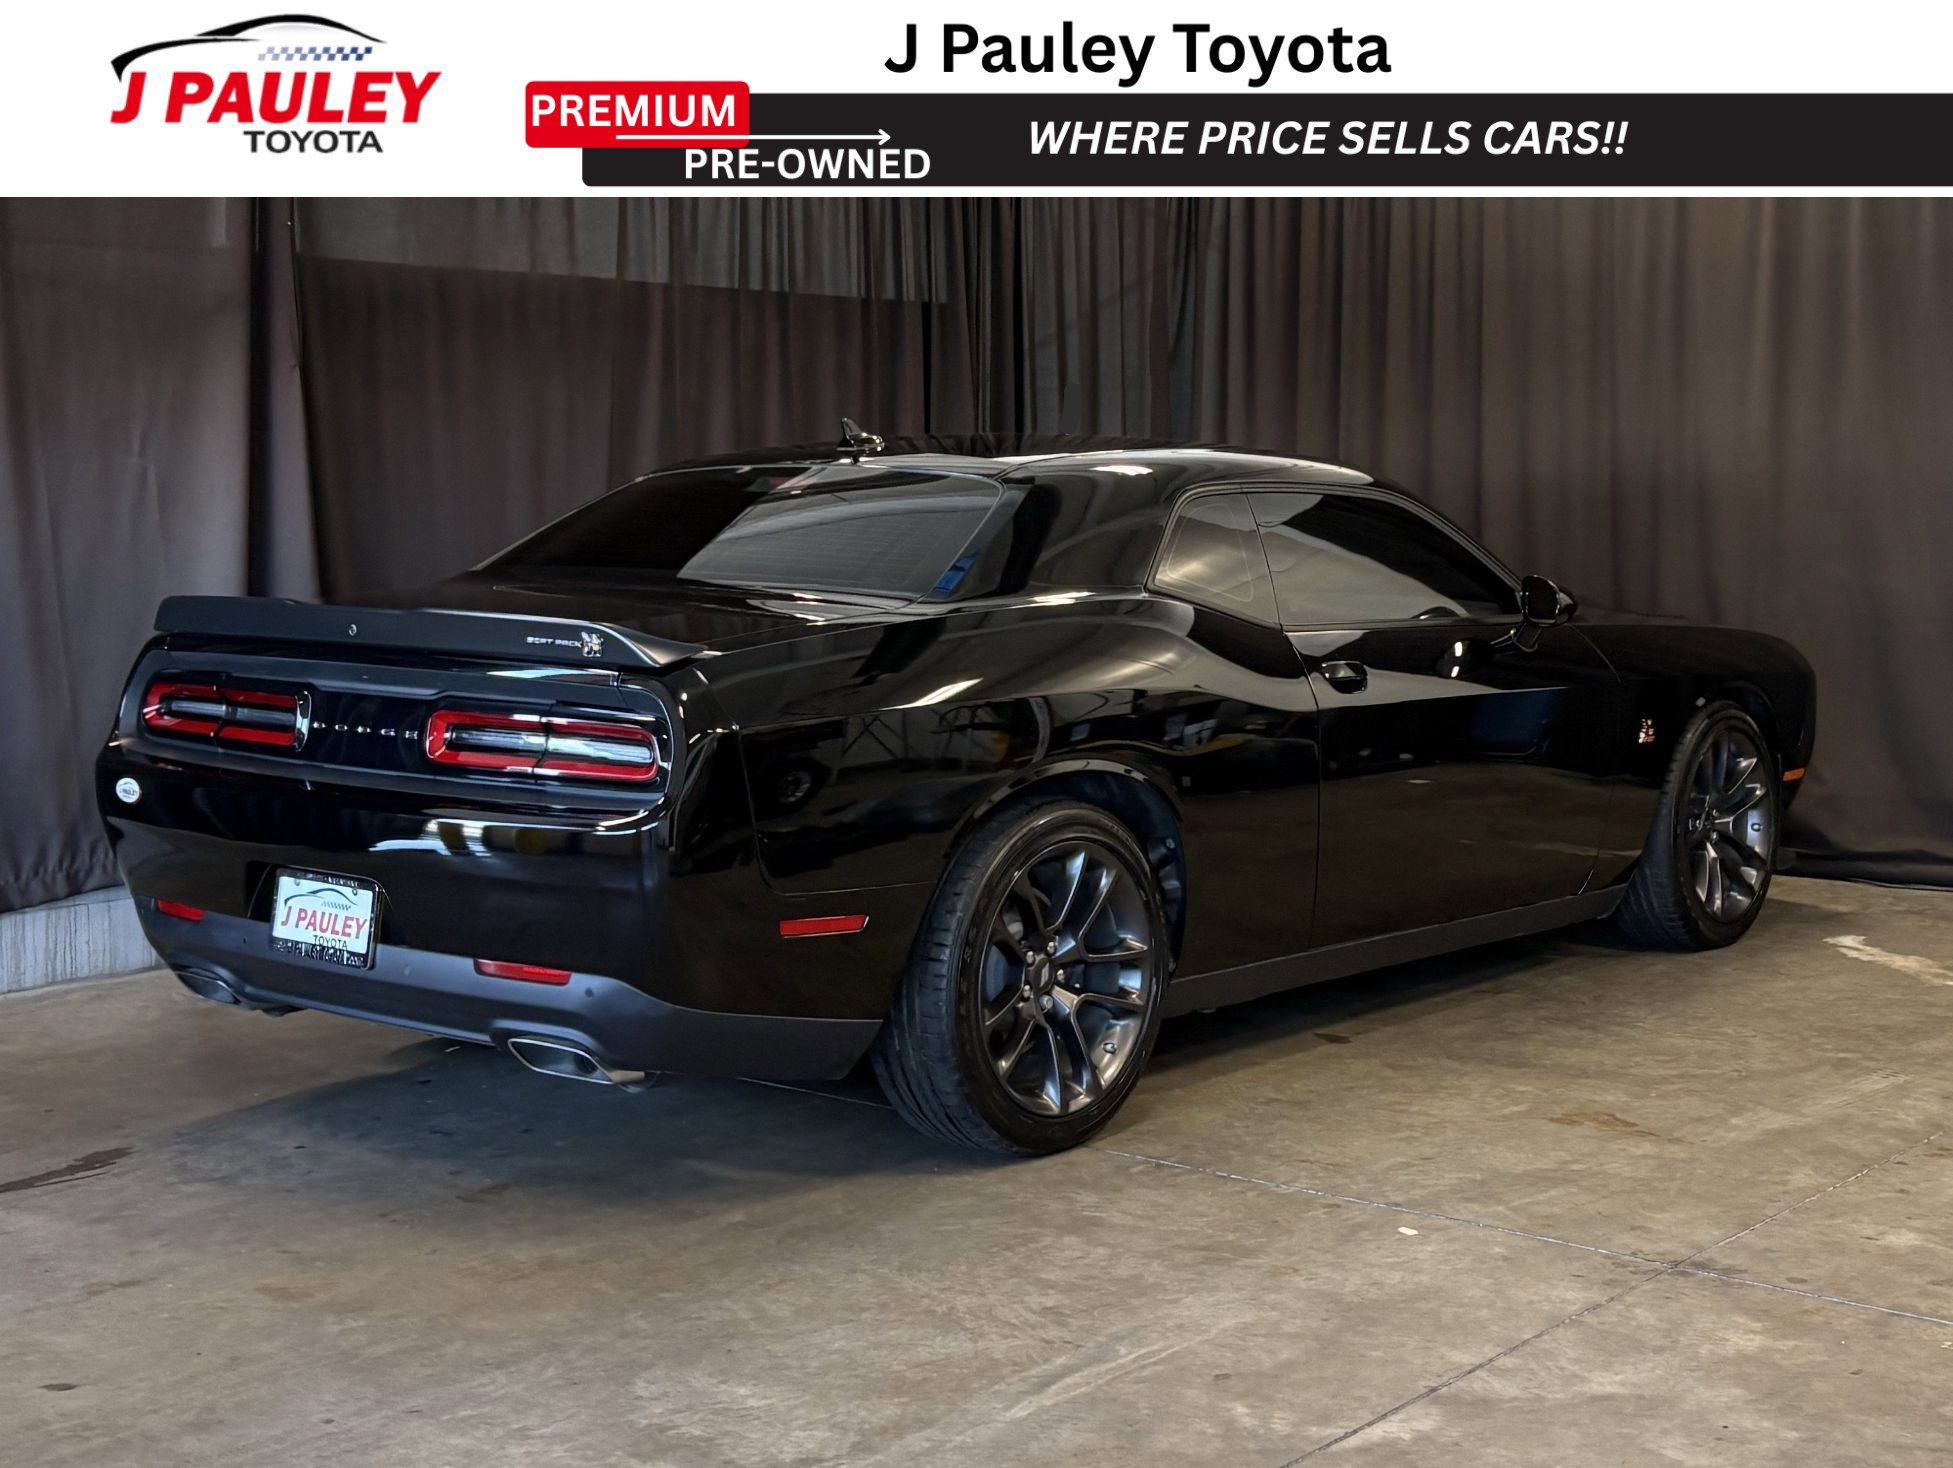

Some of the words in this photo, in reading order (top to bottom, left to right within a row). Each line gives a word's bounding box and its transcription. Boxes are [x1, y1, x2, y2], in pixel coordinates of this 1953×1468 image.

[280, 905, 292, 926] J
[295, 907, 368, 939] PAULEY
[313, 934, 348, 950] TOYOTA
